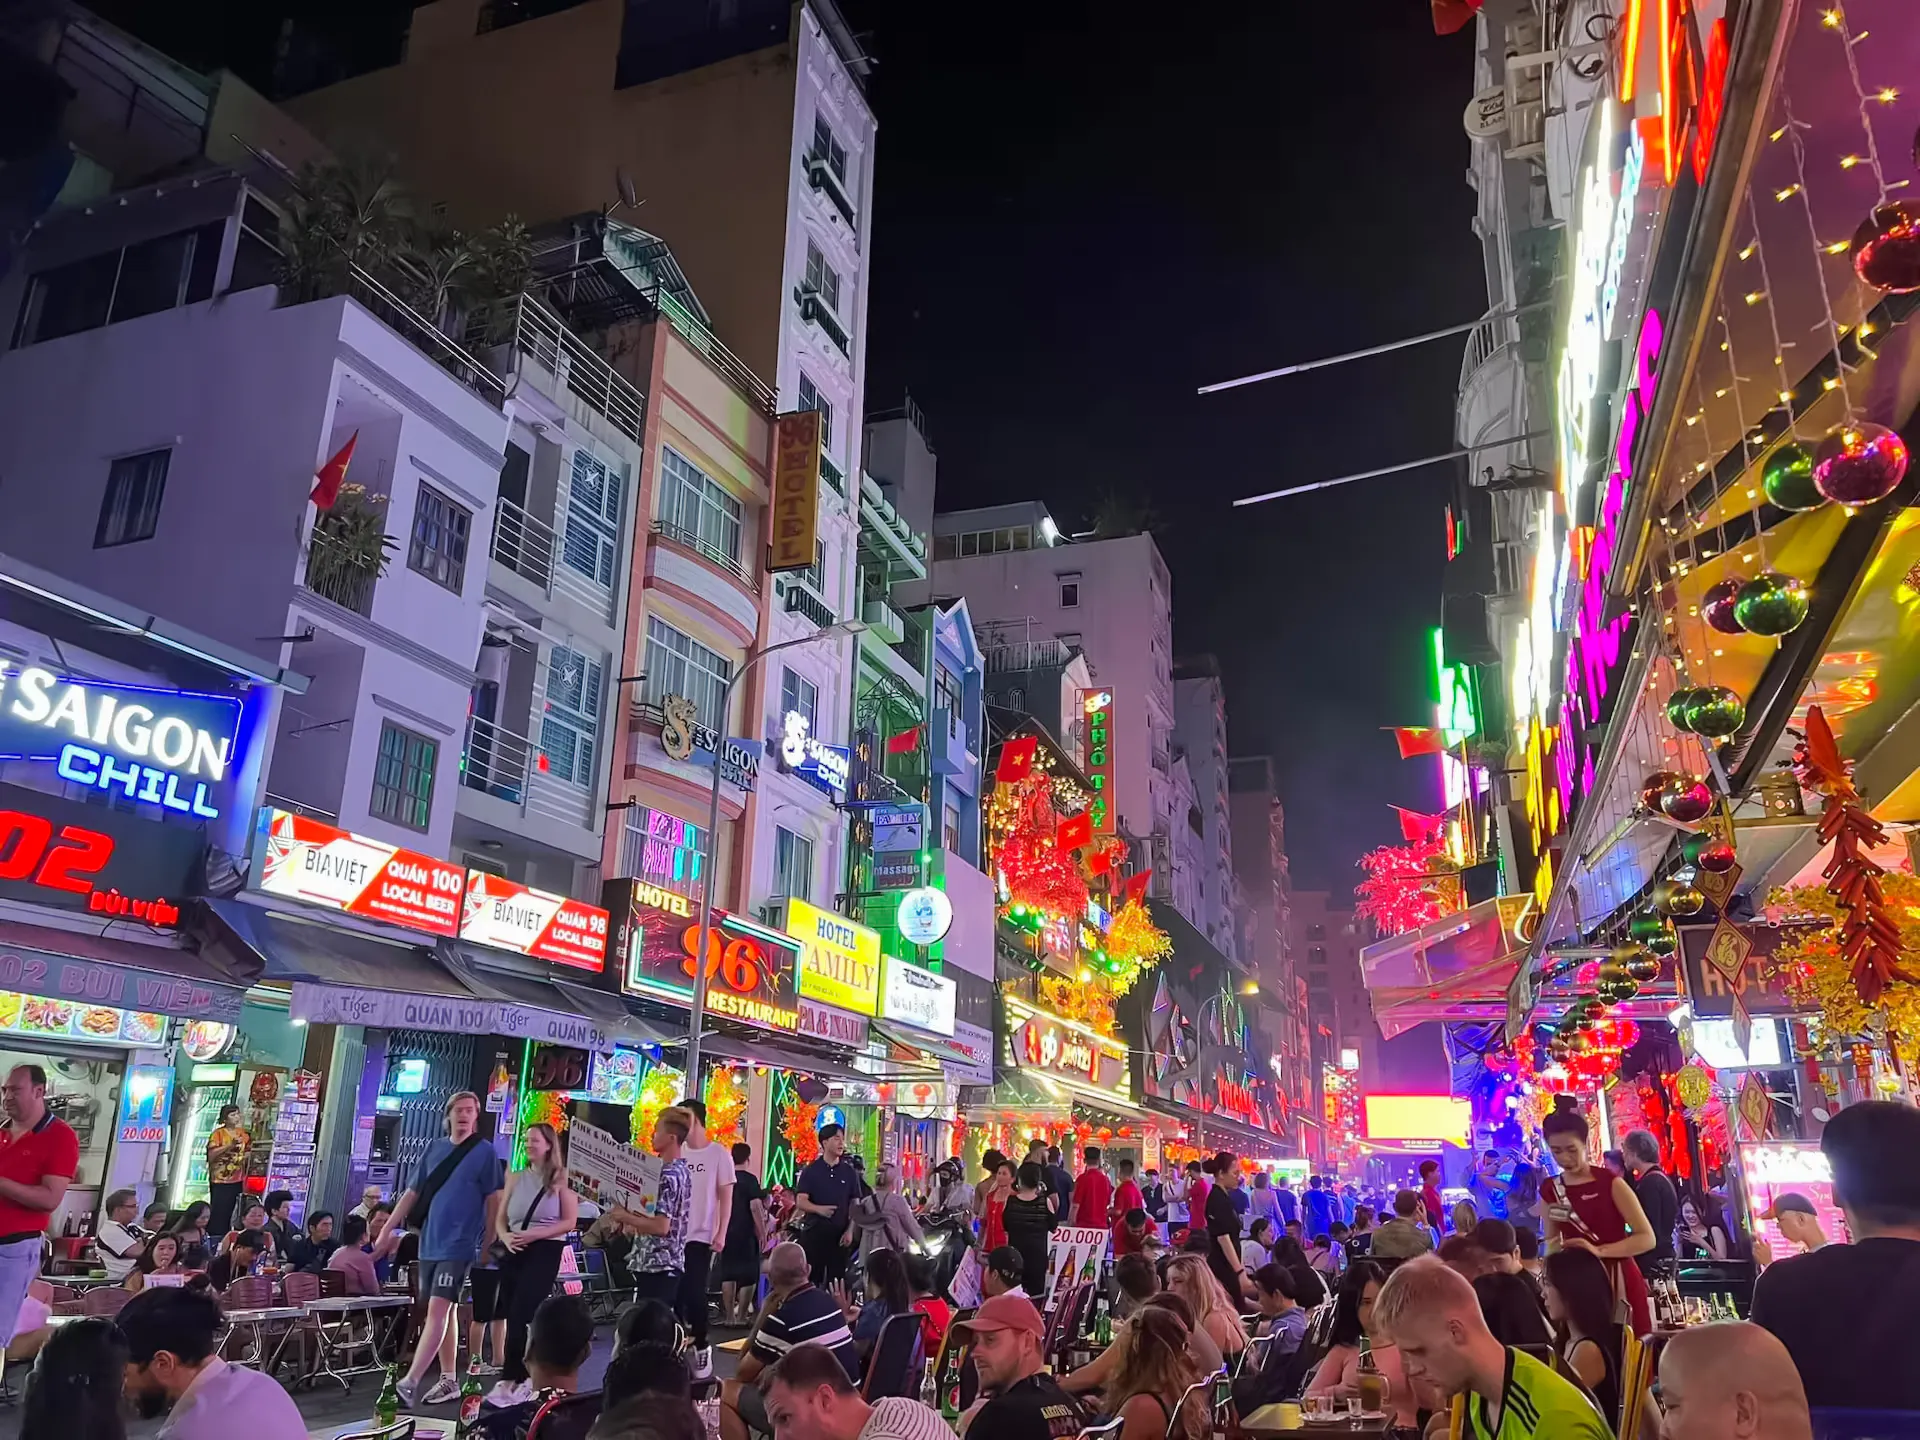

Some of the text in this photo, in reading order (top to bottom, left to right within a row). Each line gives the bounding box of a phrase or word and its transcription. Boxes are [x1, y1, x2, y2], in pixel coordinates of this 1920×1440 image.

[779, 415, 815, 560] 96 HOTEL
[11, 667, 230, 781] SAIGON
[811, 740, 850, 778] SAIGON
[58, 744, 219, 819] CHILL
[387, 860, 462, 895] QUÁN 100
[381, 882, 424, 906] LOCAL
[425, 894, 456, 915] BEER
[636, 882, 691, 919] HOTEL
[552, 927, 604, 951] LOCAL BEER
[556, 909, 606, 935] QUÁN 98
[816, 916, 857, 950] HOTEL
[681, 924, 759, 993] 96
[801, 941, 876, 993] AMILY
[58, 964, 126, 1002] BÙI
[340, 996, 484, 1029] Tiger QUÁN 100
[499, 1006, 606, 1048] Tiger QUÁN 98
[706, 990, 799, 1030] RESTAURANT
[799, 1004, 816, 1034] PA
[830, 1013, 863, 1044] NAIL
[533, 1050, 583, 1088] 96
[121, 1126, 165, 1141] 20.000
[571, 1119, 592, 1137] PINK
[616, 1166, 644, 1186] SHISHA
[1051, 1228, 1104, 1245] 20.000
[438, 1272, 454, 1287] th
